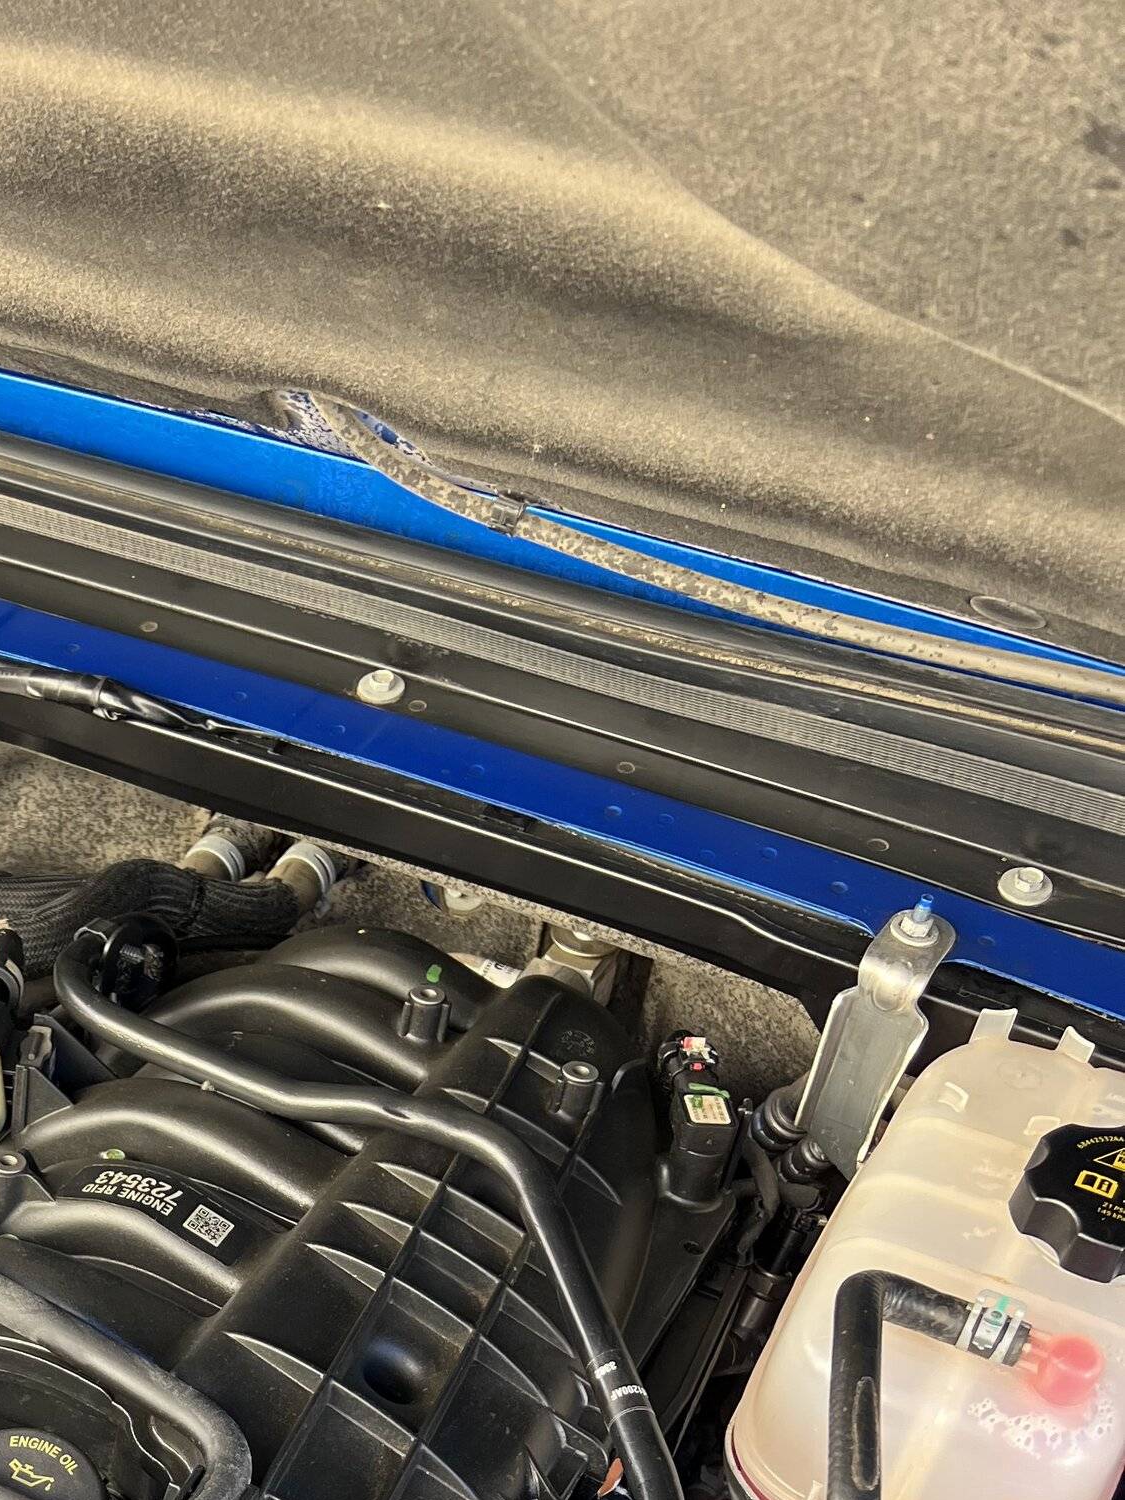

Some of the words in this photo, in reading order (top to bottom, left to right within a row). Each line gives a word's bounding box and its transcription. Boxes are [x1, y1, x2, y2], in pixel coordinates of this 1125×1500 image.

[81, 1183, 118, 1194] RFID
[94, 1170, 184, 1207] 723543
[117, 1190, 174, 1216] ENGINE
[9, 1435, 62, 1458] ENGINE
[59, 1454, 79, 1475] OIL
